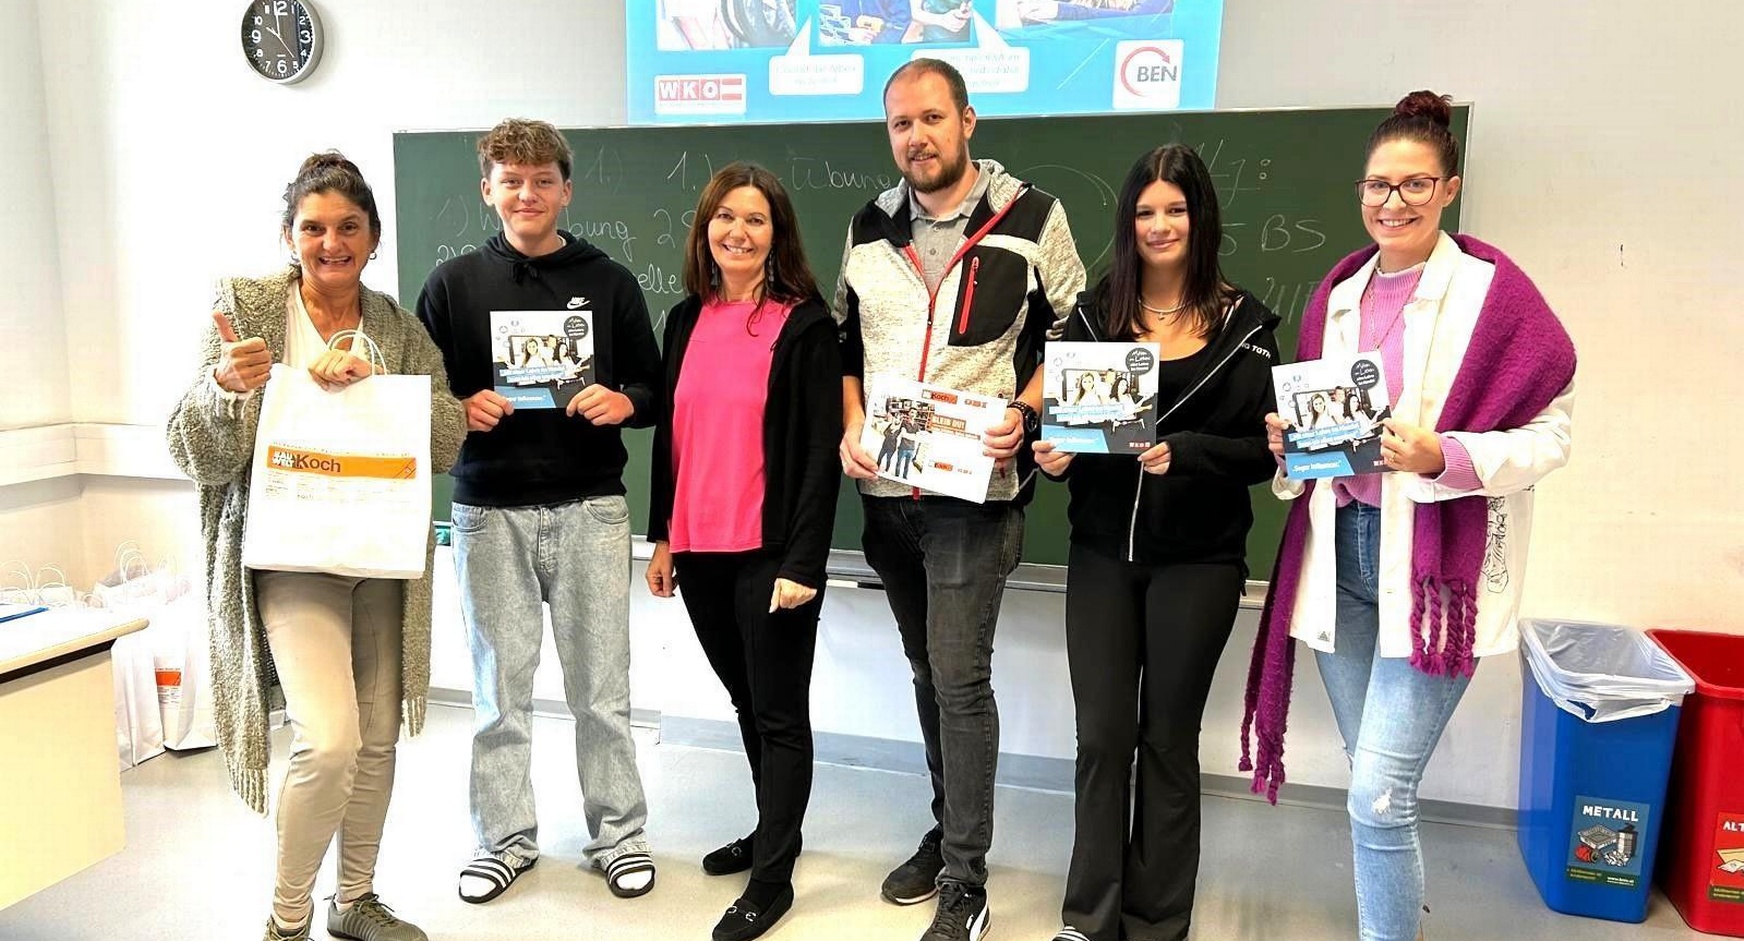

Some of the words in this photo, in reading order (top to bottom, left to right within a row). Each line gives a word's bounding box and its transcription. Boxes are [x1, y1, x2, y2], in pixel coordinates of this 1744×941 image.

[273, 0, 288, 15] 12
[254, 15, 263, 25] 10
[299, 15, 306, 25] 2
[251, 29, 262, 43] 9
[299, 29, 312, 43] 3
[256, 48, 264, 57] 8
[300, 48, 307, 57] 4
[265, 60, 271, 72] 7
[276, 59, 287, 73] 6
[292, 60, 299, 69] 5
[1136, 65, 1178, 83] BEN
[659, 80, 719, 100] WKO
[1261, 214, 1327, 256] BS
[296, 454, 341, 473] Koch
[1583, 805, 1639, 822] METALL
